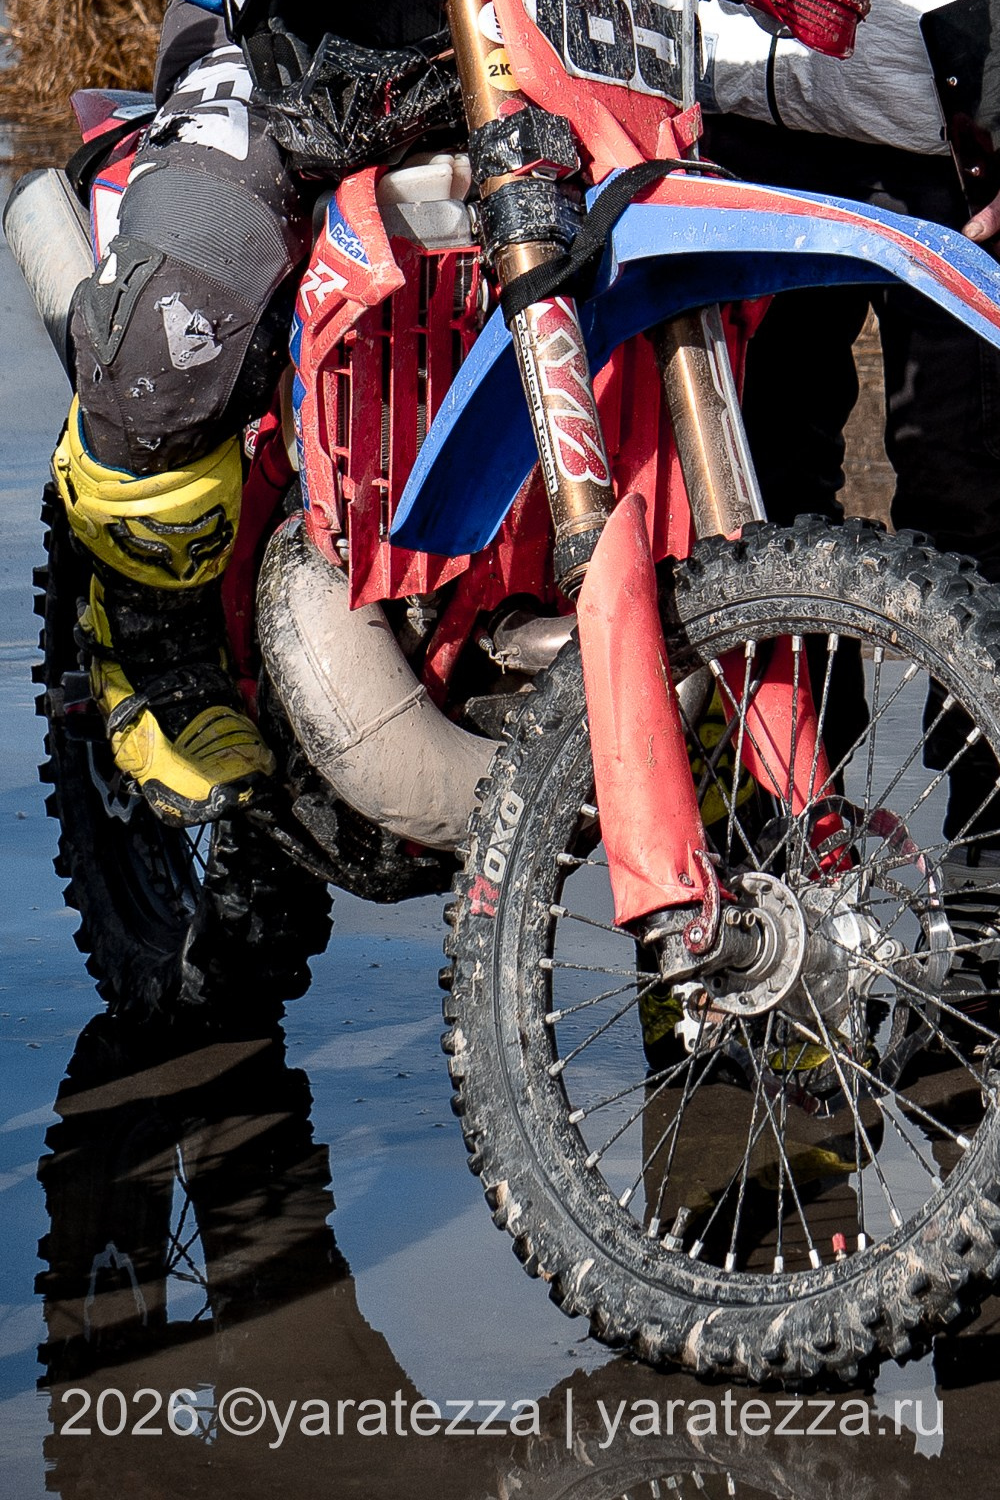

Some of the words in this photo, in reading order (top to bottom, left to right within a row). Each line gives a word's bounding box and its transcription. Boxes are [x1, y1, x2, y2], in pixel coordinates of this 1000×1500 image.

[488, 63, 512, 77] 2K
[330, 224, 363, 260] Beta
[537, 417, 557, 492] Touch
